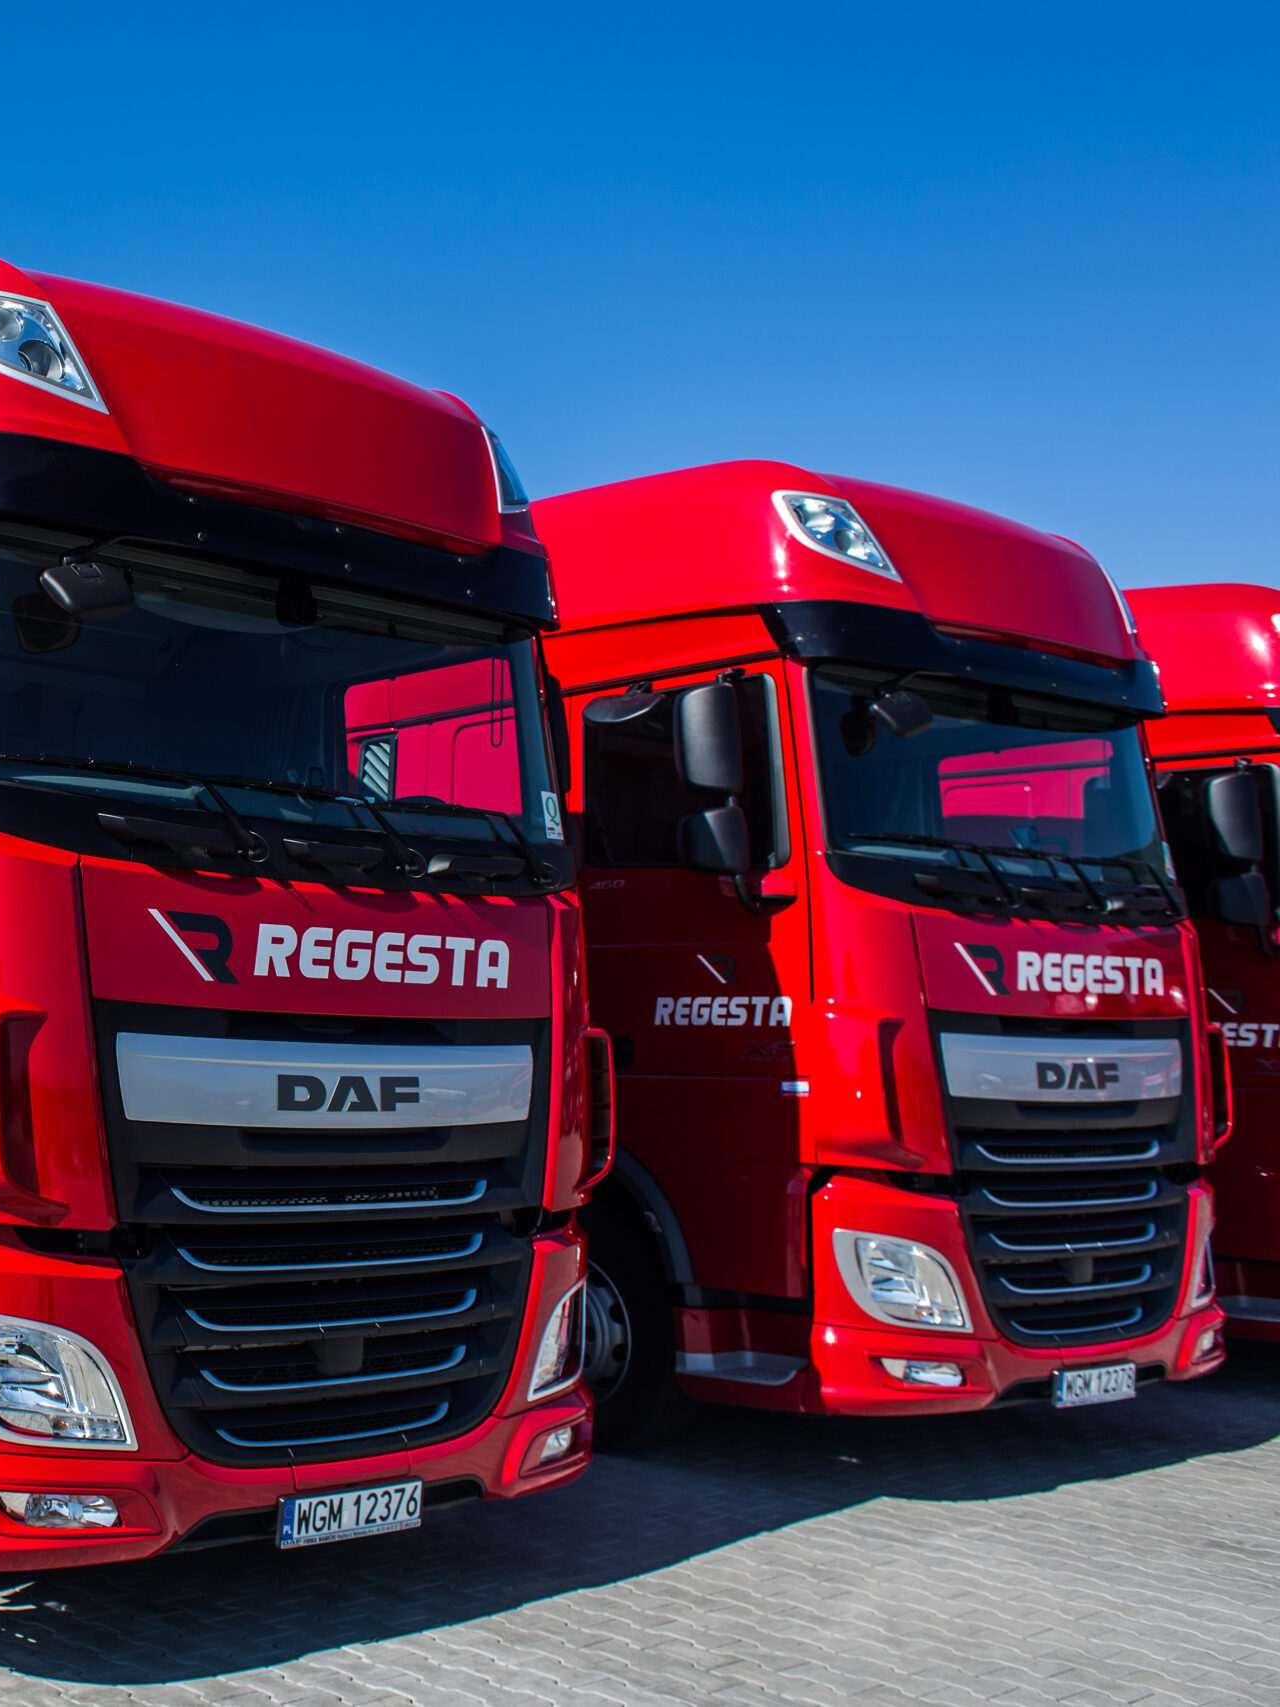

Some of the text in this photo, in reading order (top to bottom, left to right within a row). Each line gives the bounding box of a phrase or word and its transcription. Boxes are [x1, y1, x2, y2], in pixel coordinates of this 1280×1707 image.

[589, 878, 626, 891] 460
[253, 922, 510, 989] REGESTA
[1017, 950, 1165, 997] REGESTA
[654, 996, 793, 1027] REGESTA
[276, 1073, 421, 1113] DAF
[1035, 1061, 1120, 1090] DAF
[282, 1484, 419, 1536] PL WGM 12376
